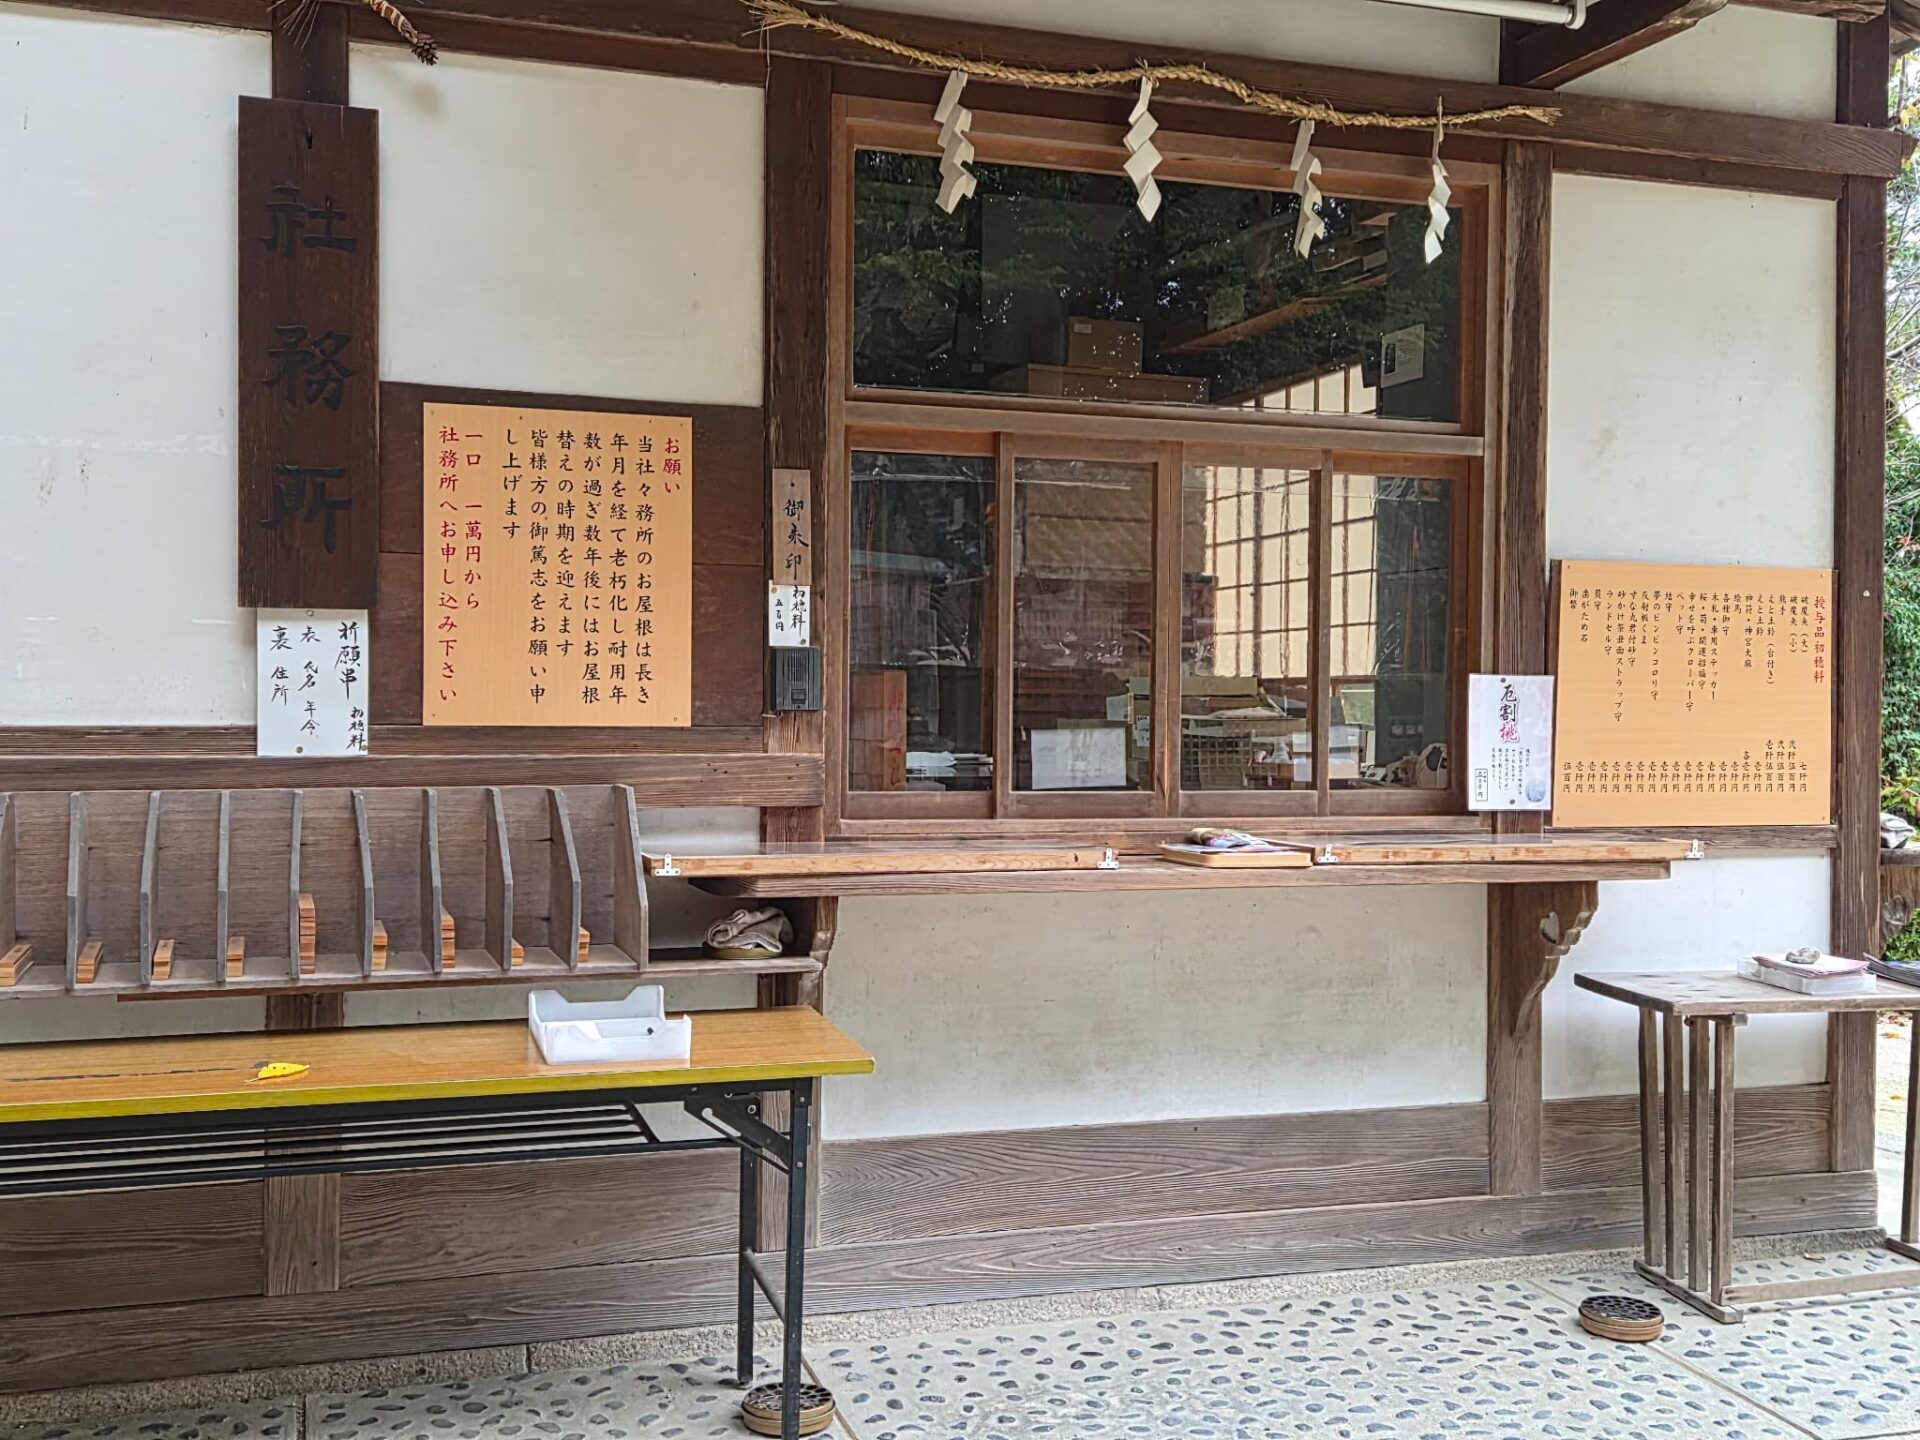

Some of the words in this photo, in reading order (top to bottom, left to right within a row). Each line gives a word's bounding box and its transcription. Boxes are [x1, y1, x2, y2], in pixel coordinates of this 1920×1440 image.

[260, 180, 359, 554] 社務所
[465, 433, 483, 467] 一口
[502, 429, 523, 539] し上げます
[662, 437, 681, 493] お願い
[438, 426, 460, 701] 社務所へお申し込み下さい
[464, 503, 482, 610] 一萬円から
[528, 429, 548, 704] 皆様方の御篤志をお願い申
[554, 430, 576, 657] 替えの時期を迎えます
[580, 432, 604, 704] 数が過ぎ数年後にはお屋根
[608, 433, 629, 704] 年月を経て老朽化し耐用年
[634, 436, 655, 704] 当社々務所のお屋根は長き
[784, 498, 809, 580] 御朱印
[270, 625, 293, 651] 裏
[301, 625, 320, 643] 表
[775, 599, 785, 632] 五百円
[789, 585, 807, 638] 初穂料
[1813, 595, 1826, 683] 授与品初穂料
[271, 666, 289, 706] 住所
[334, 621, 361, 701] 祈願串
[1500, 684, 1518, 740] 厄割桃
